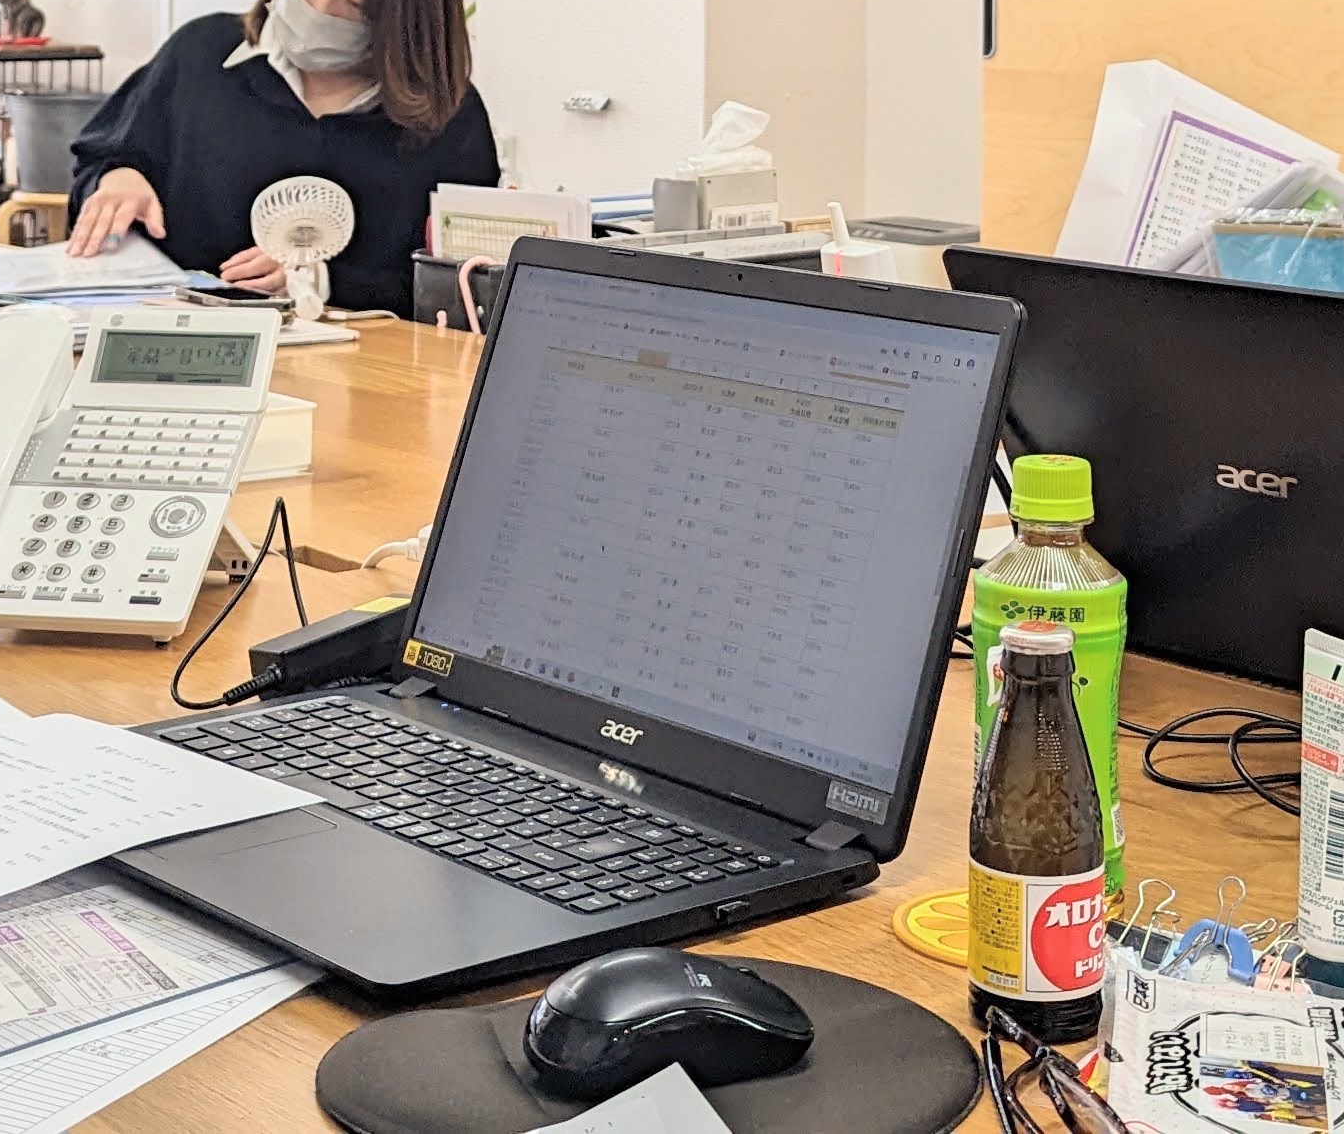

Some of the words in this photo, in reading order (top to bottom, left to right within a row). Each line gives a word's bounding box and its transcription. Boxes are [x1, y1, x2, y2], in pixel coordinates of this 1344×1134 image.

[1216, 464, 1297, 498] acer
[83, 494, 94, 502] 2
[119, 495, 128, 503] 3
[39, 516, 49, 524] 4
[74, 517, 84, 525] 5
[108, 518, 118, 526] 6
[64, 541, 74, 549] 8
[99, 543, 109, 551] 9
[53, 567, 63, 575] 0
[87, 568, 98, 577] #
[1027, 605, 1085, 623] 伊藤園
[423, 651, 446, 670] 1080
[600, 719, 644, 745] acer
